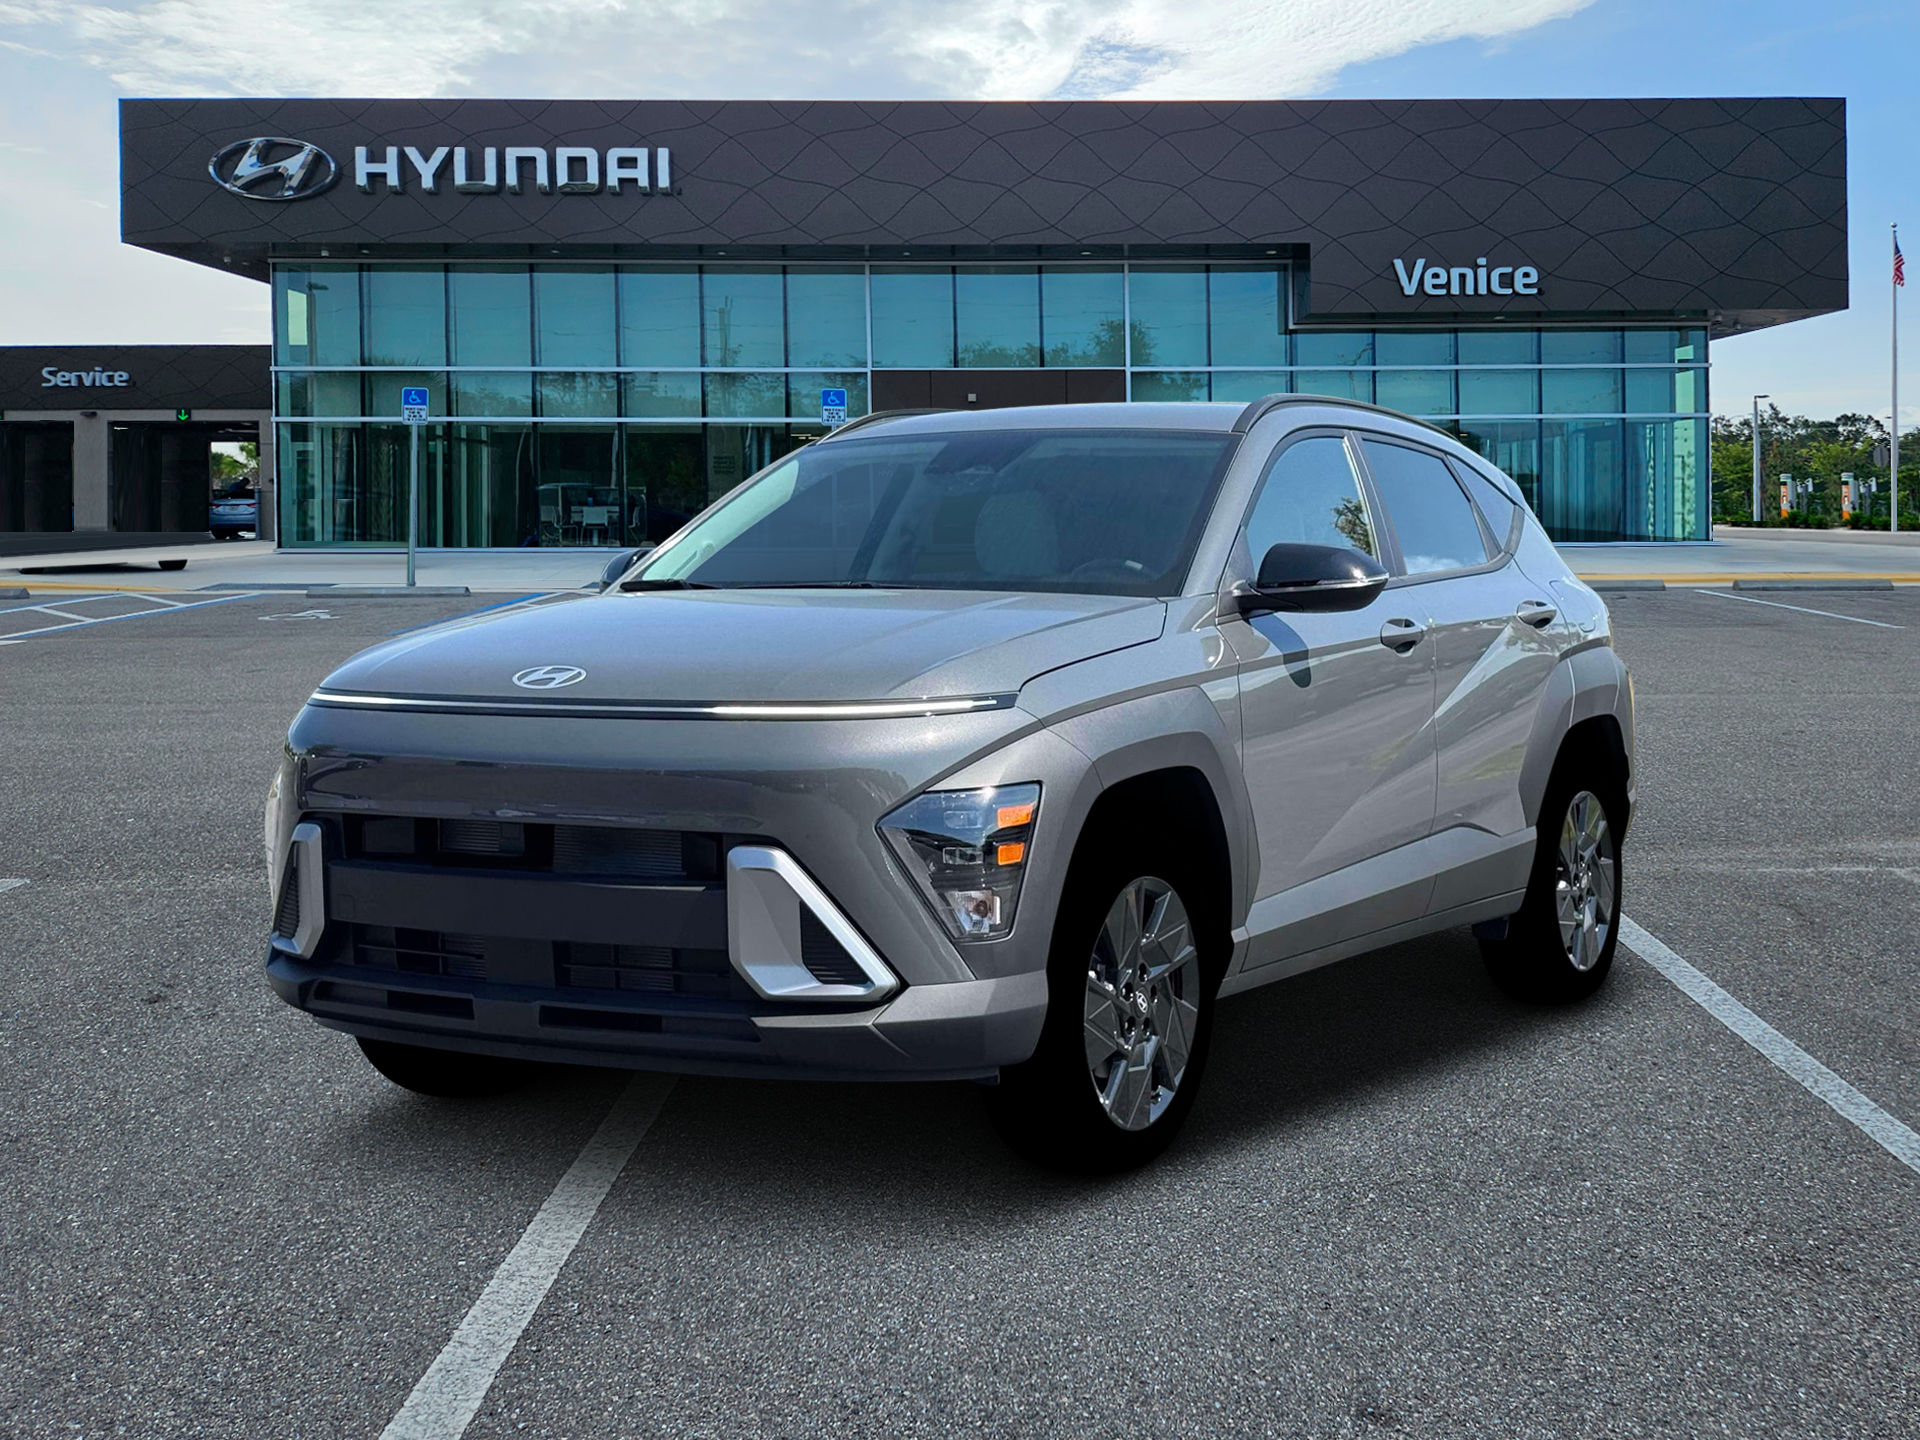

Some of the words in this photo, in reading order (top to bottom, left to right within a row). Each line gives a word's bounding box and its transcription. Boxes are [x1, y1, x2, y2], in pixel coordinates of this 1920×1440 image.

[353, 145, 672, 195] HYUNDAI
[1392, 256, 1539, 296] Venice
[41, 366, 130, 387] Service
